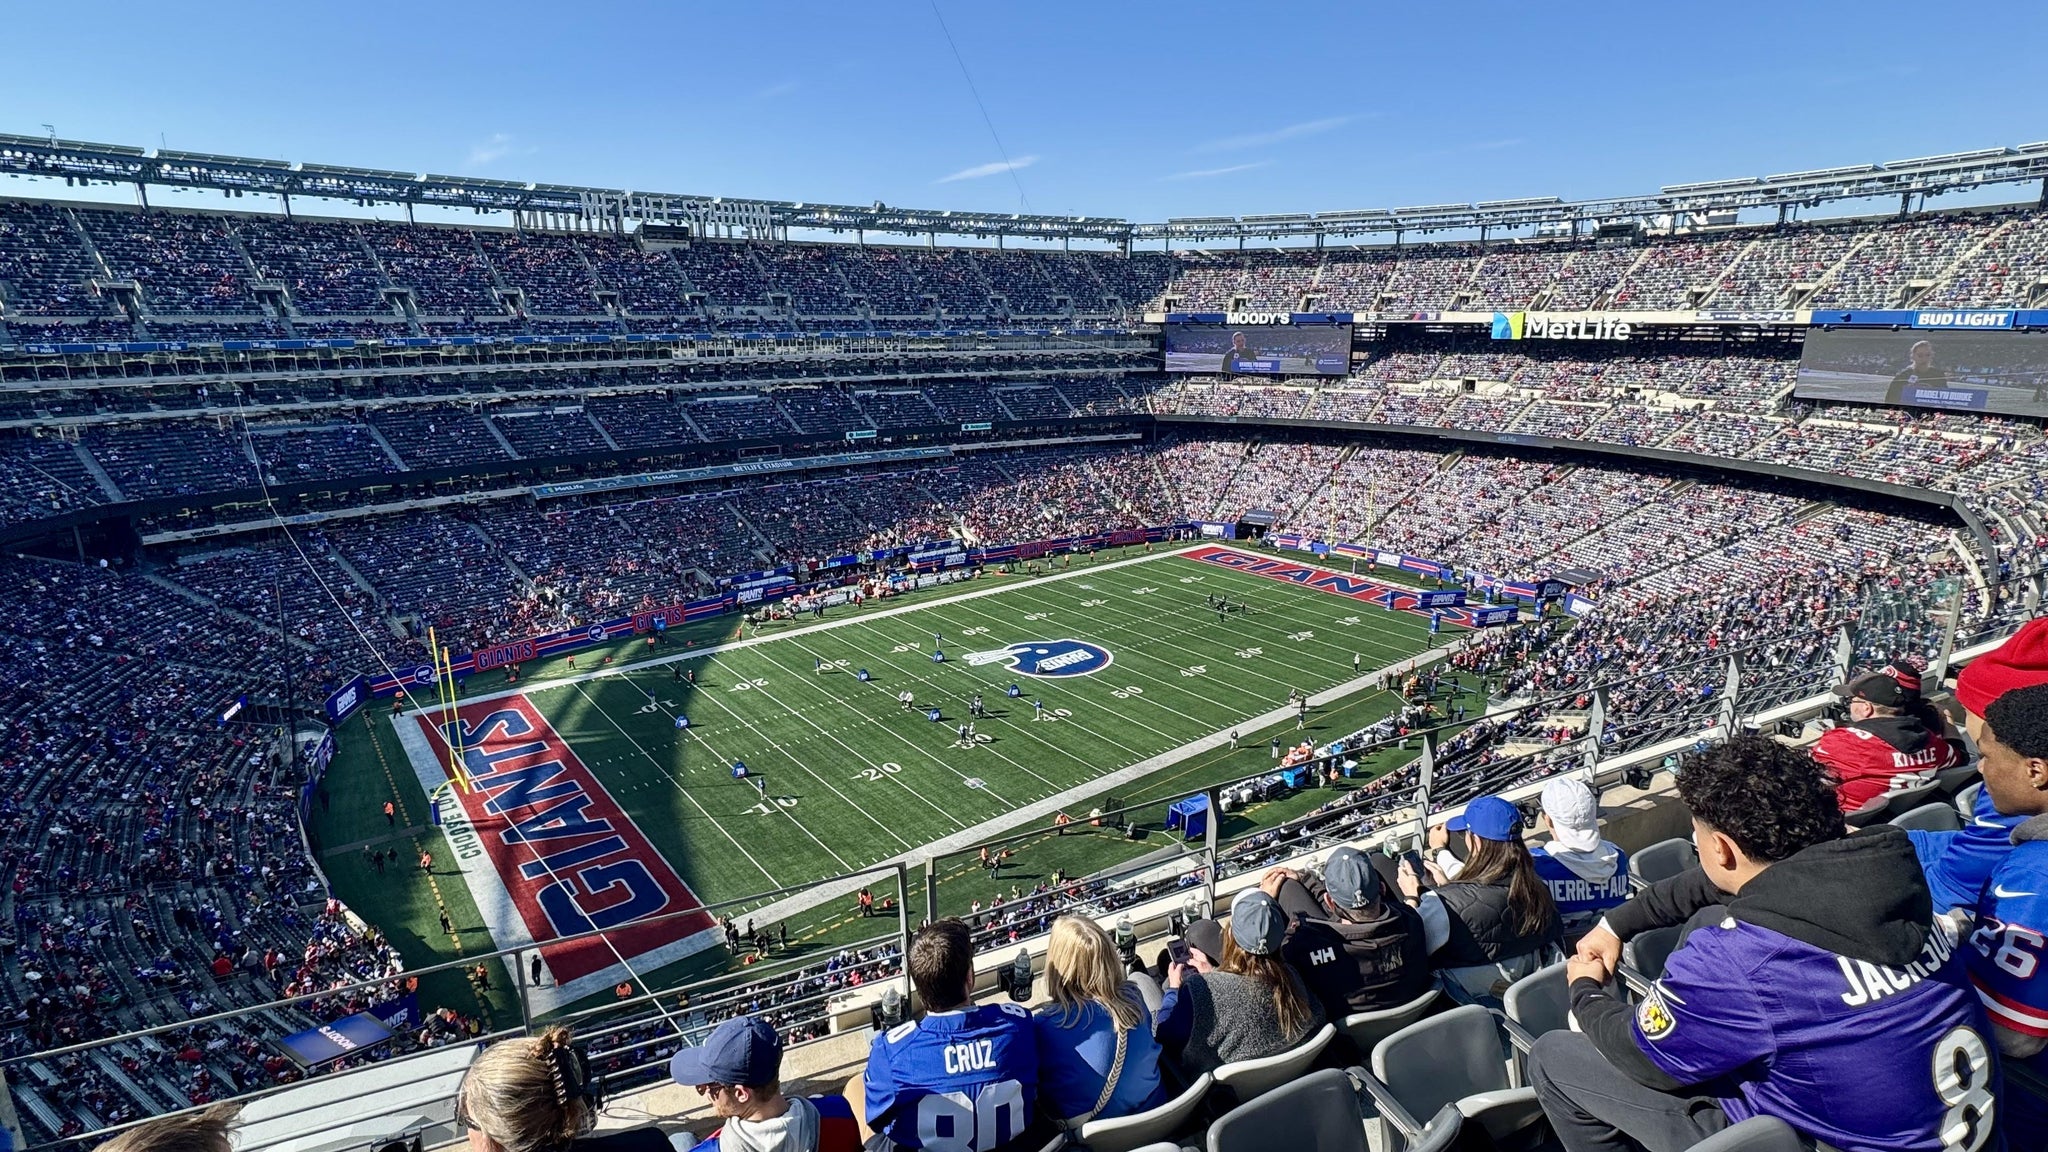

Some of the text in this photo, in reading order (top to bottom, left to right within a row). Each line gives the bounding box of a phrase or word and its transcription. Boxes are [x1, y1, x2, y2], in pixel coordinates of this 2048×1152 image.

[580, 190, 675, 225] METLIFE
[682, 198, 773, 230] STADIUM
[1226, 312, 1290, 324] MOODY'S
[1917, 313, 2010, 326] BUD LIGHT
[1526, 317, 1631, 340] MetLife
[733, 460, 794, 473] METLIFE STADIUM
[652, 473, 679, 481] MetLife
[554, 483, 585, 492] MetLife
[190, 528, 220, 538] verizon
[738, 587, 764, 602] GIANTS
[1431, 594, 1457, 605] GIANTS
[1487, 610, 1510, 622] GIANTS
[478, 642, 533, 668] GIANTS
[1180, 665, 1206, 677] 40
[735, 677, 769, 691] 20
[1111, 686, 1144, 698] 50
[1891, 747, 1937, 768] KITTLE
[862, 762, 902, 781] 20
[751, 795, 798, 816] 10
[438, 708, 671, 938] GIANTS
[443, 813, 482, 860] CHOOSE
[1544, 874, 1628, 902] IERRE-PAUL
[1309, 946, 1337, 966] HH
[383, 1008, 408, 1029] ANTS
[319, 1025, 358, 1051] MOODY'S
[944, 1039, 997, 1074] CRUZ
[1932, 1025, 1995, 1152] 8
